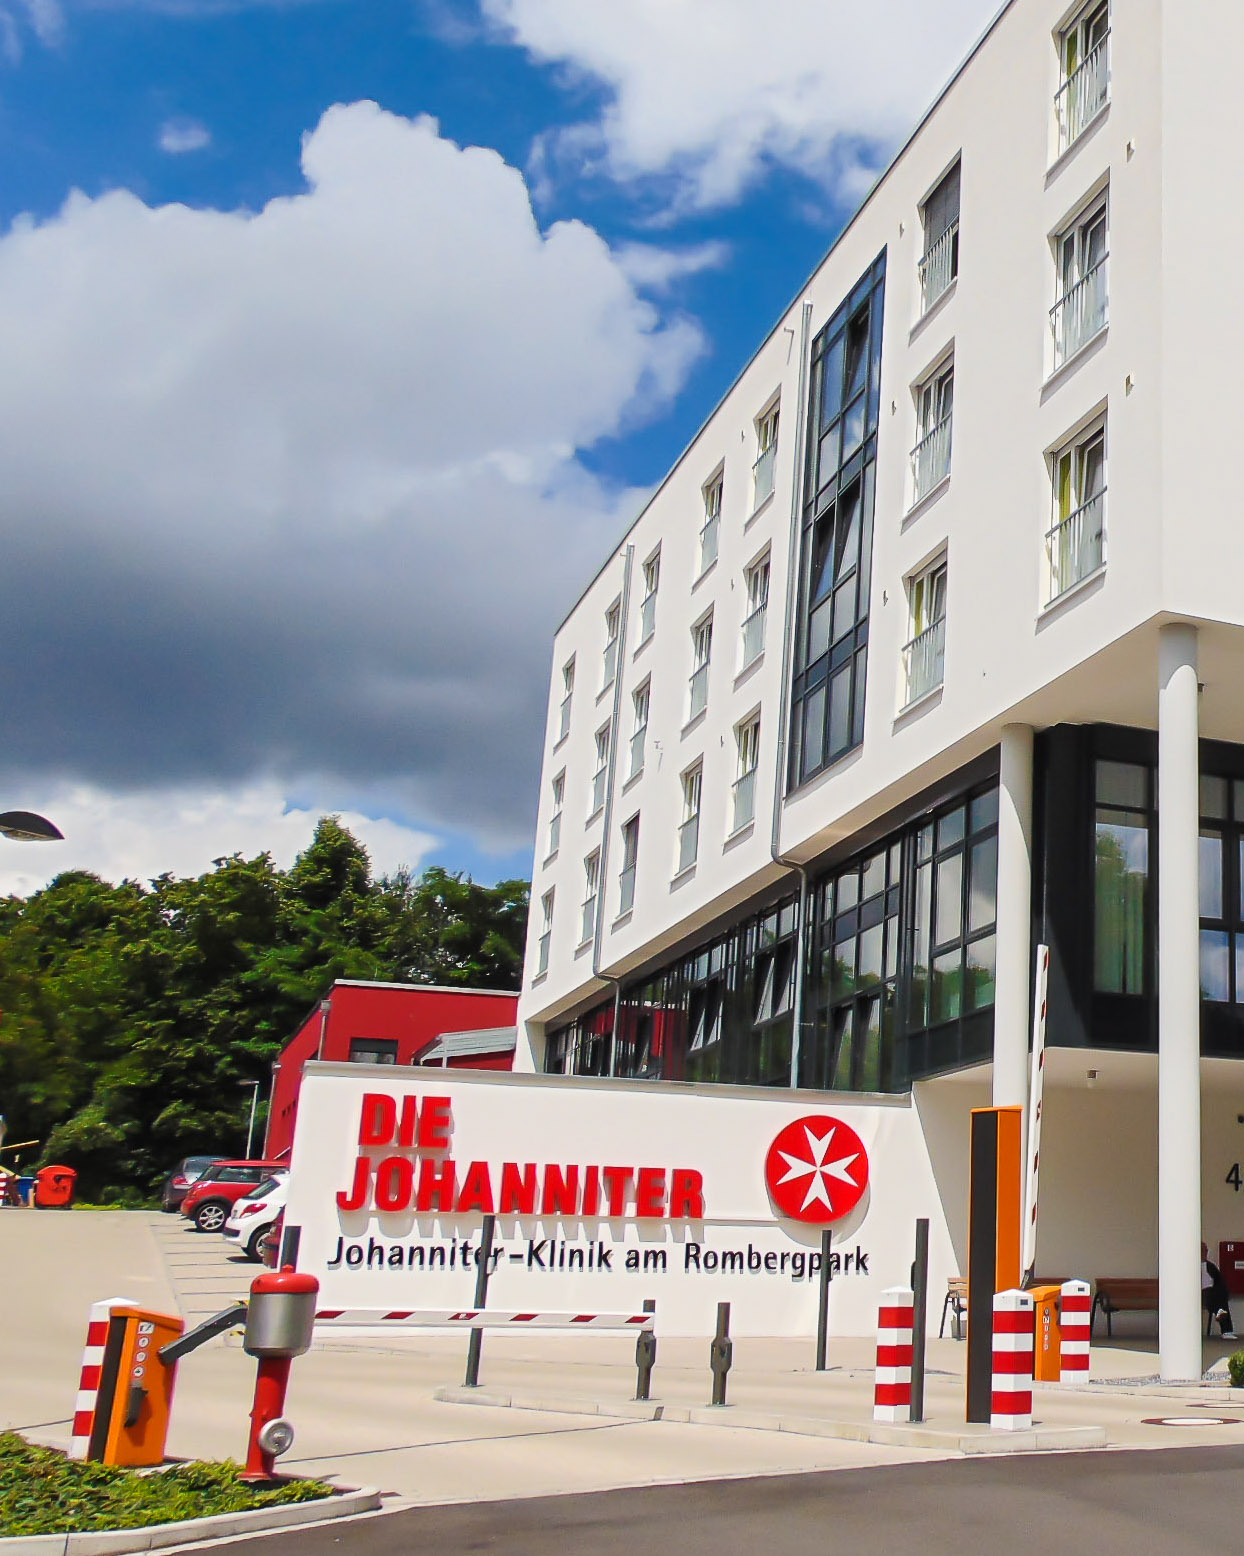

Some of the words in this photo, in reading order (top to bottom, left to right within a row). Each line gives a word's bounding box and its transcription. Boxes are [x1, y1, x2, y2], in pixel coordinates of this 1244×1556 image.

[358, 1093, 452, 1148] DIE
[336, 1155, 704, 1218] JOHANNITER
[625, 1248, 667, 1268] am
[684, 1242, 870, 1278] Rombergpark
